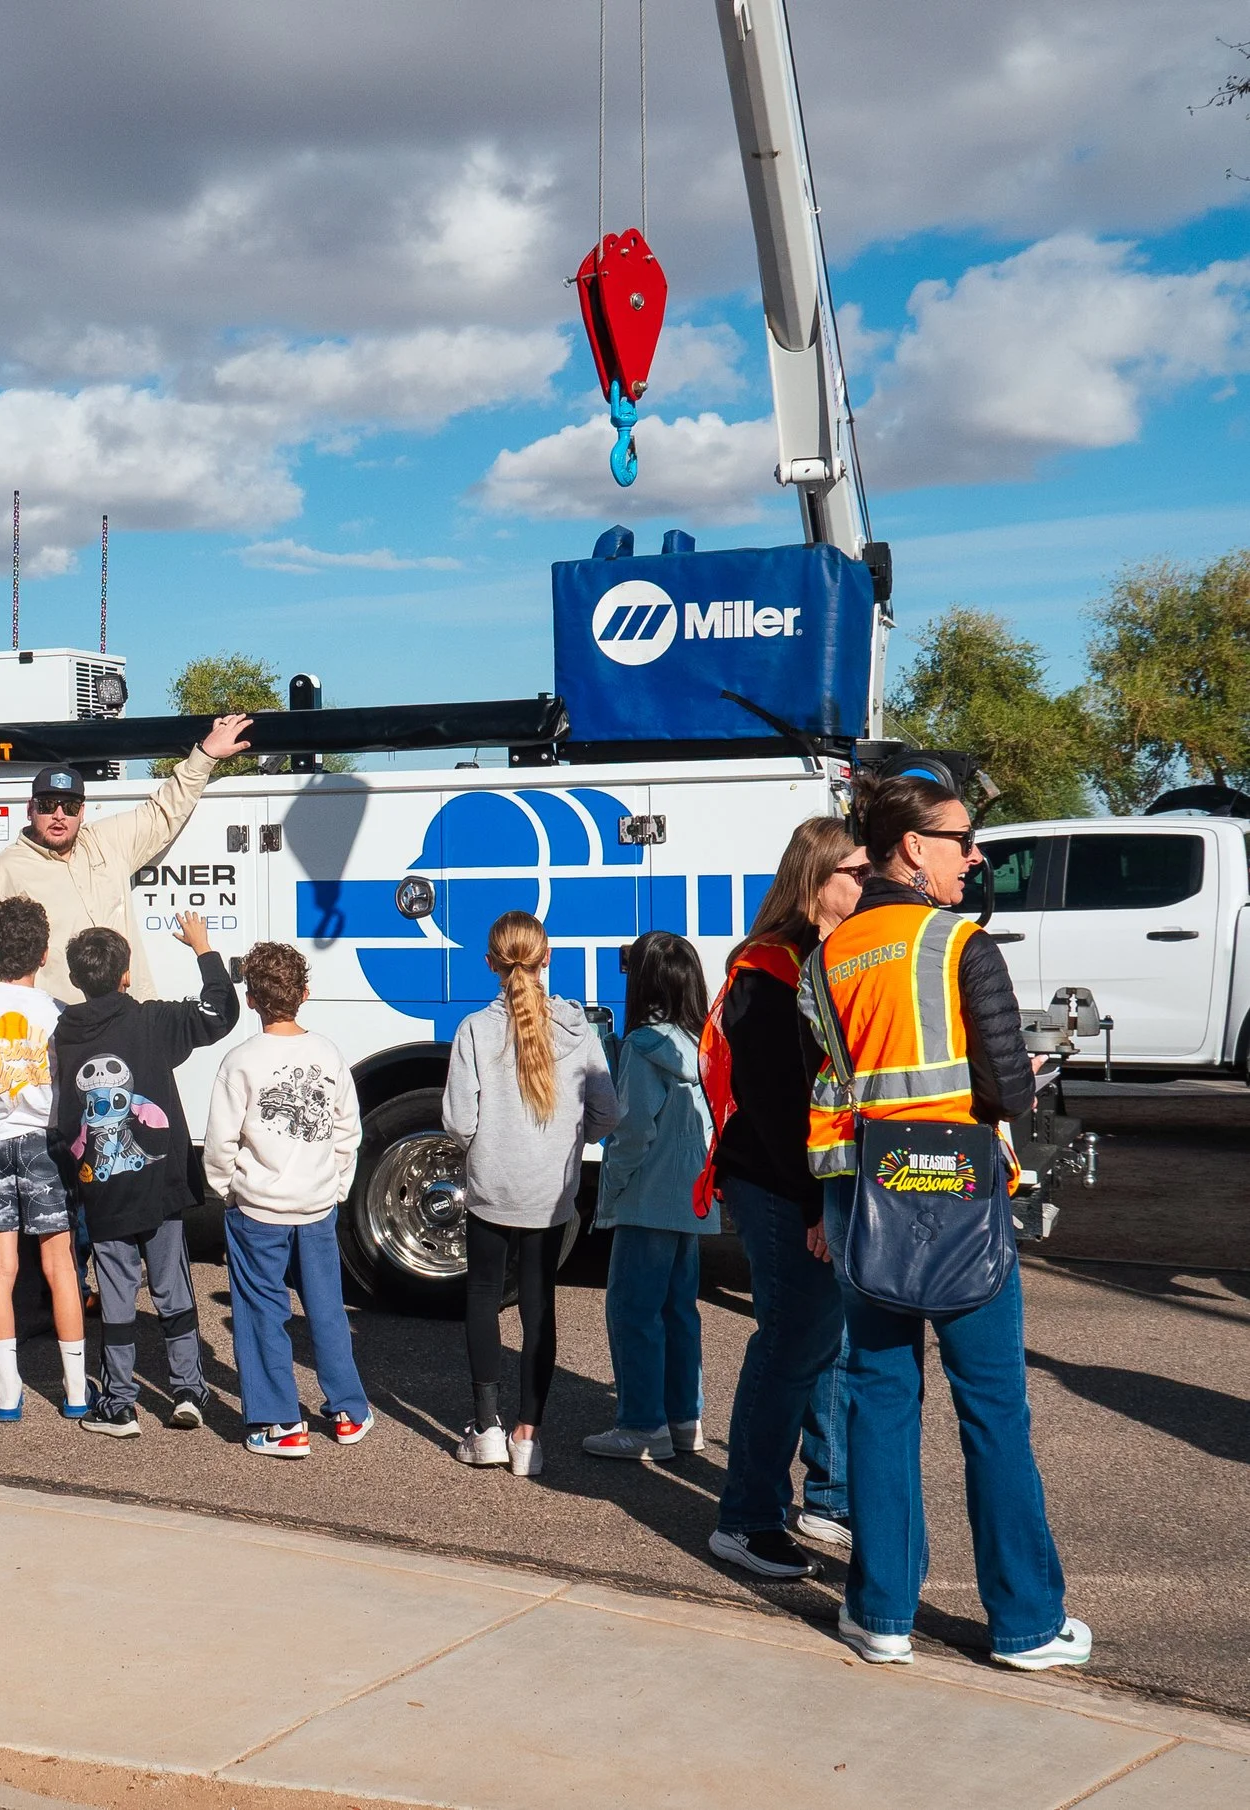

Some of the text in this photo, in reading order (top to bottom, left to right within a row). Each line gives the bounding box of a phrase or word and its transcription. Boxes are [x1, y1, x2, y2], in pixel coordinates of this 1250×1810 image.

[684, 600, 801, 639] Miller
[135, 865, 236, 886] DNER
[144, 893, 236, 906] TION
[146, 915, 238, 931] OWED
[827, 941, 907, 985] TEPHENS
[908, 1153, 957, 1171] 10 REASONS
[883, 1165, 964, 1192] Awesome
